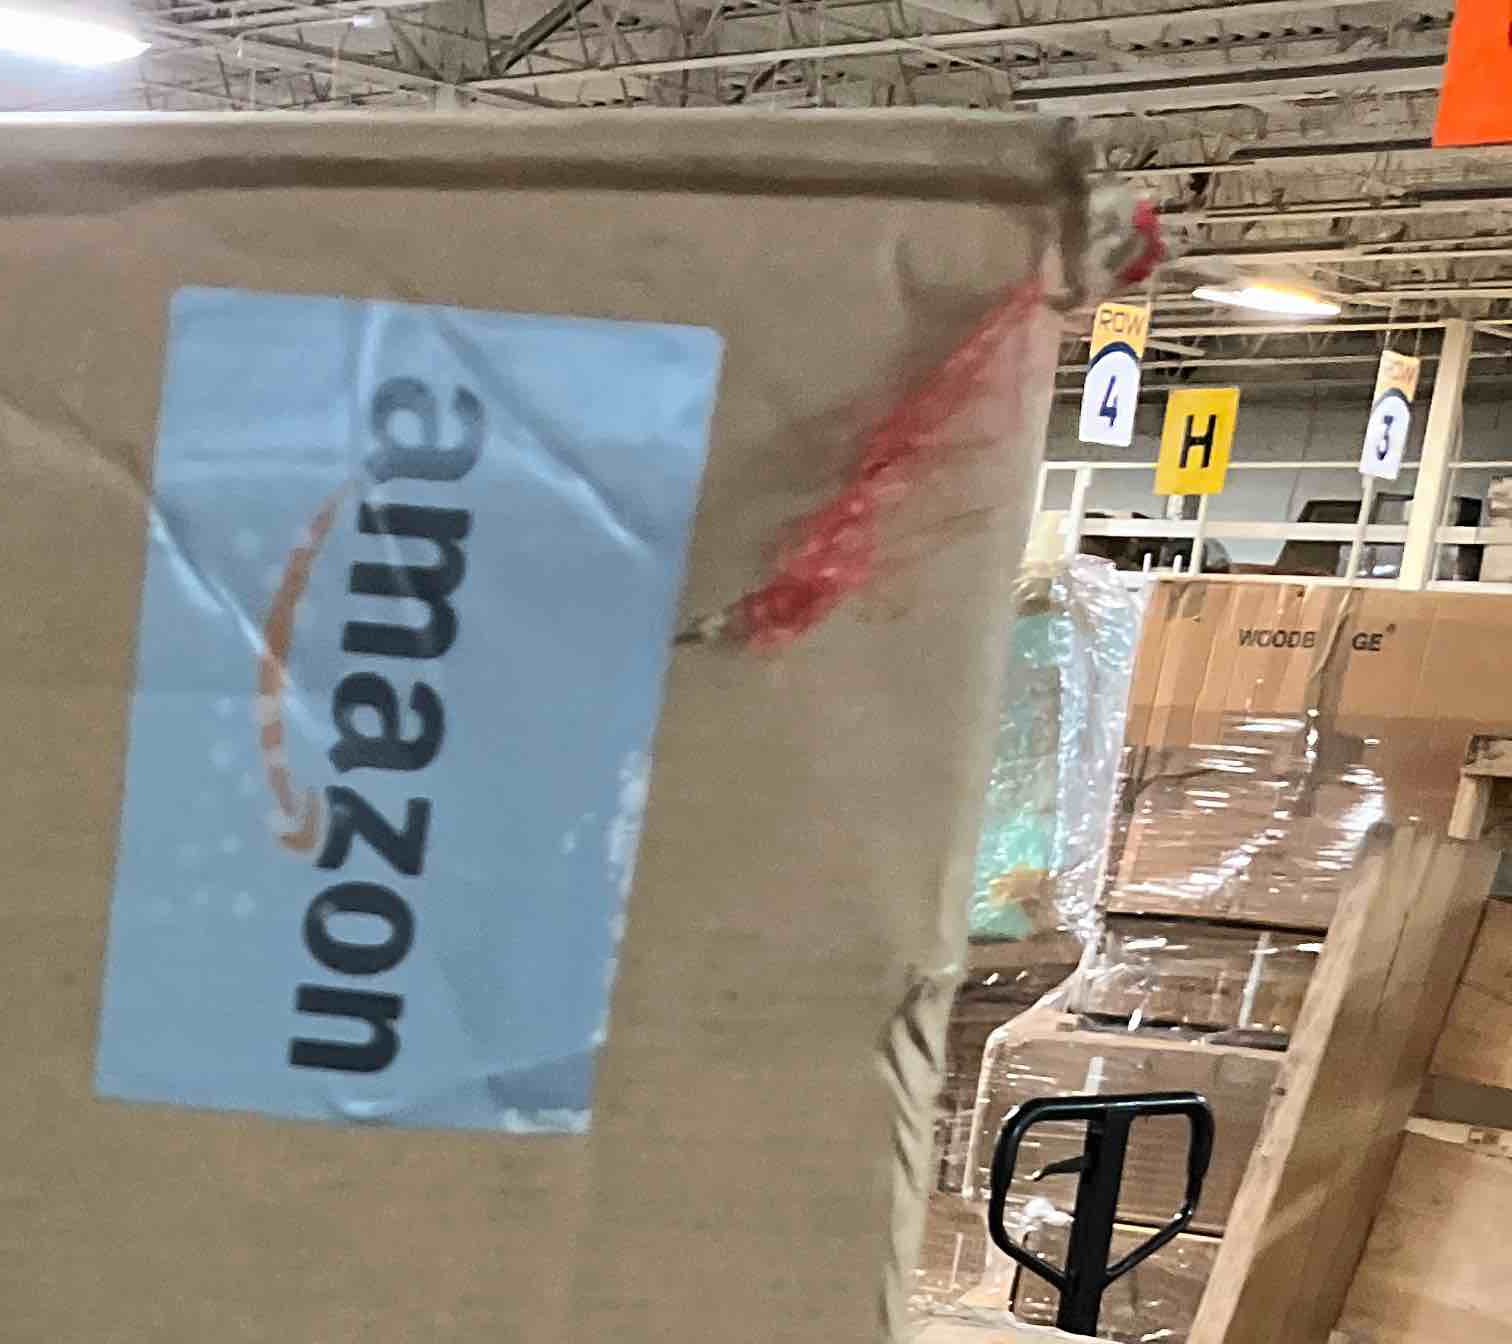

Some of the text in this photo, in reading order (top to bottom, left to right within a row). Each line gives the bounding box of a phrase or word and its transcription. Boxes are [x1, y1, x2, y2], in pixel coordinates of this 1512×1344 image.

[1099, 307, 1147, 336] ROW
[1099, 375, 1118, 427] 4
[1178, 414, 1217, 469] H
[1376, 415, 1394, 461] 3
[289, 376, 484, 1074] amazon
